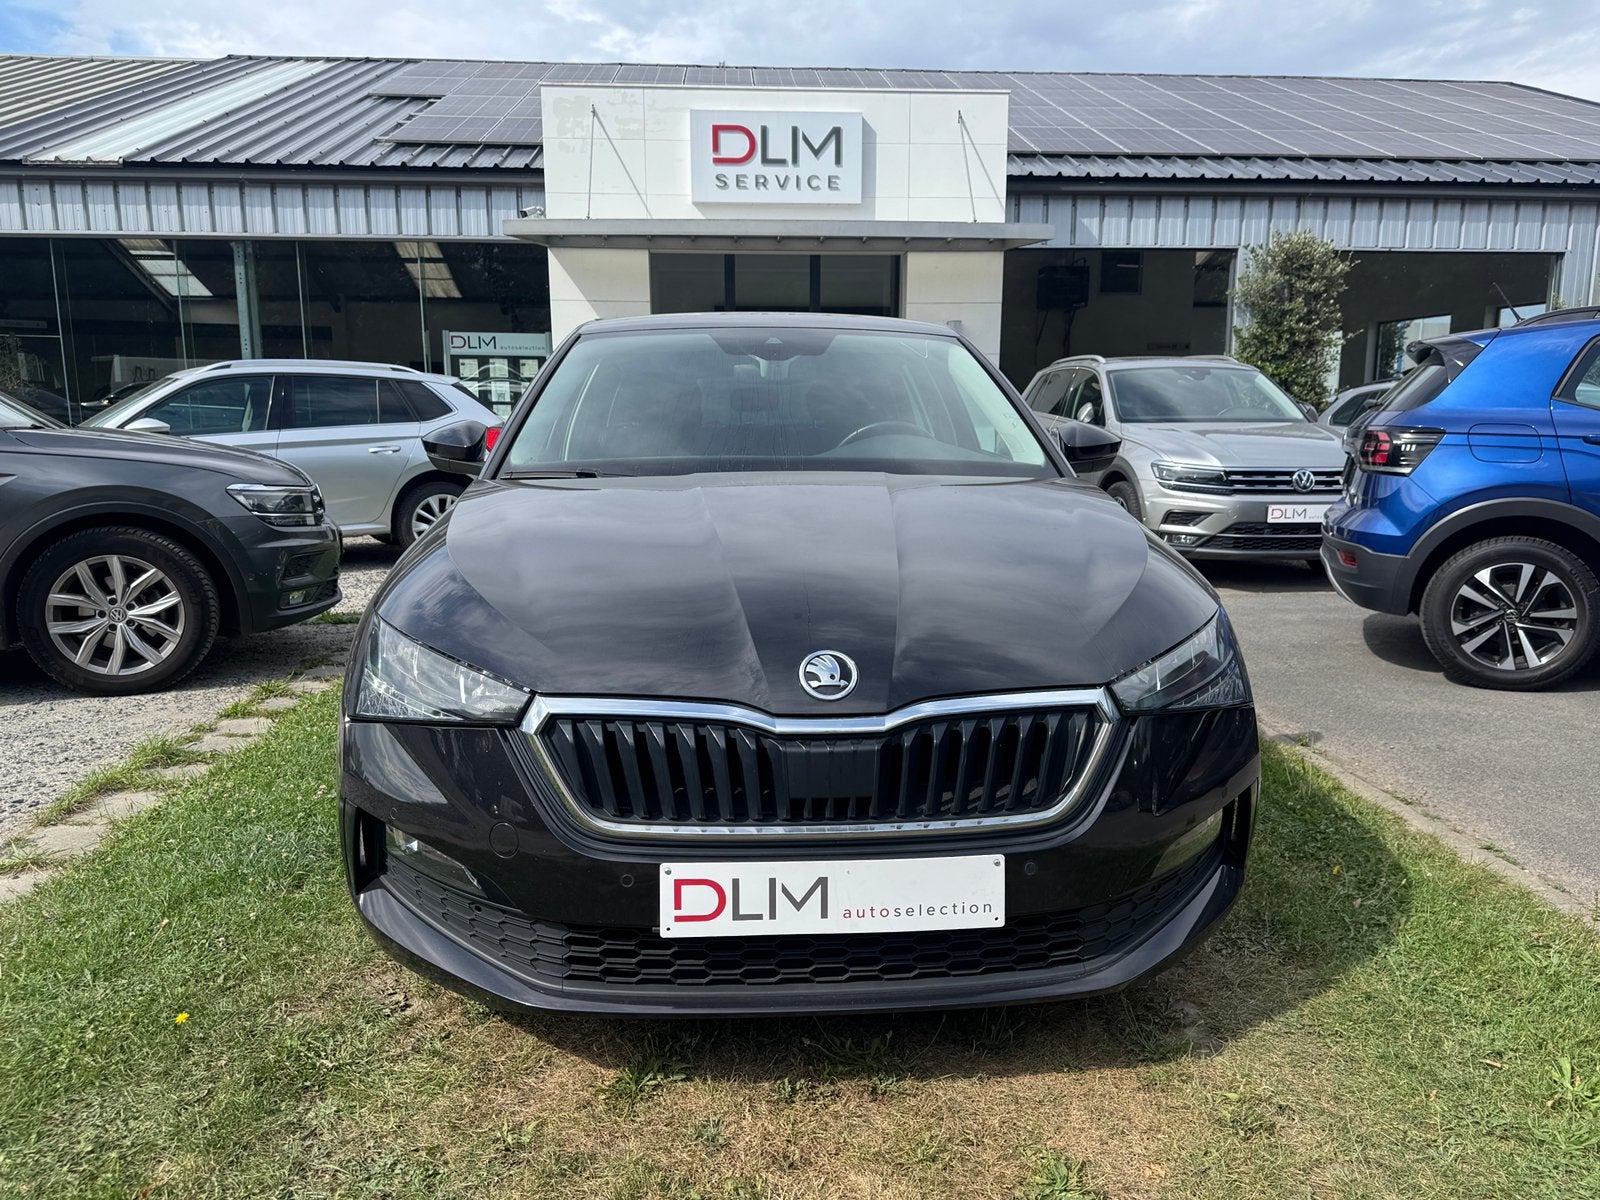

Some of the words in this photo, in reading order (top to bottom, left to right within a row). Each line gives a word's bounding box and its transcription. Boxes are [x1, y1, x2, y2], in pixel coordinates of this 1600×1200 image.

[711, 124, 842, 166] DLM
[715, 173, 841, 191] SERVICE
[450, 335, 497, 350] DLM
[1270, 508, 1307, 520] DLM
[673, 876, 829, 923] DLM
[842, 901, 993, 920] autoselection
